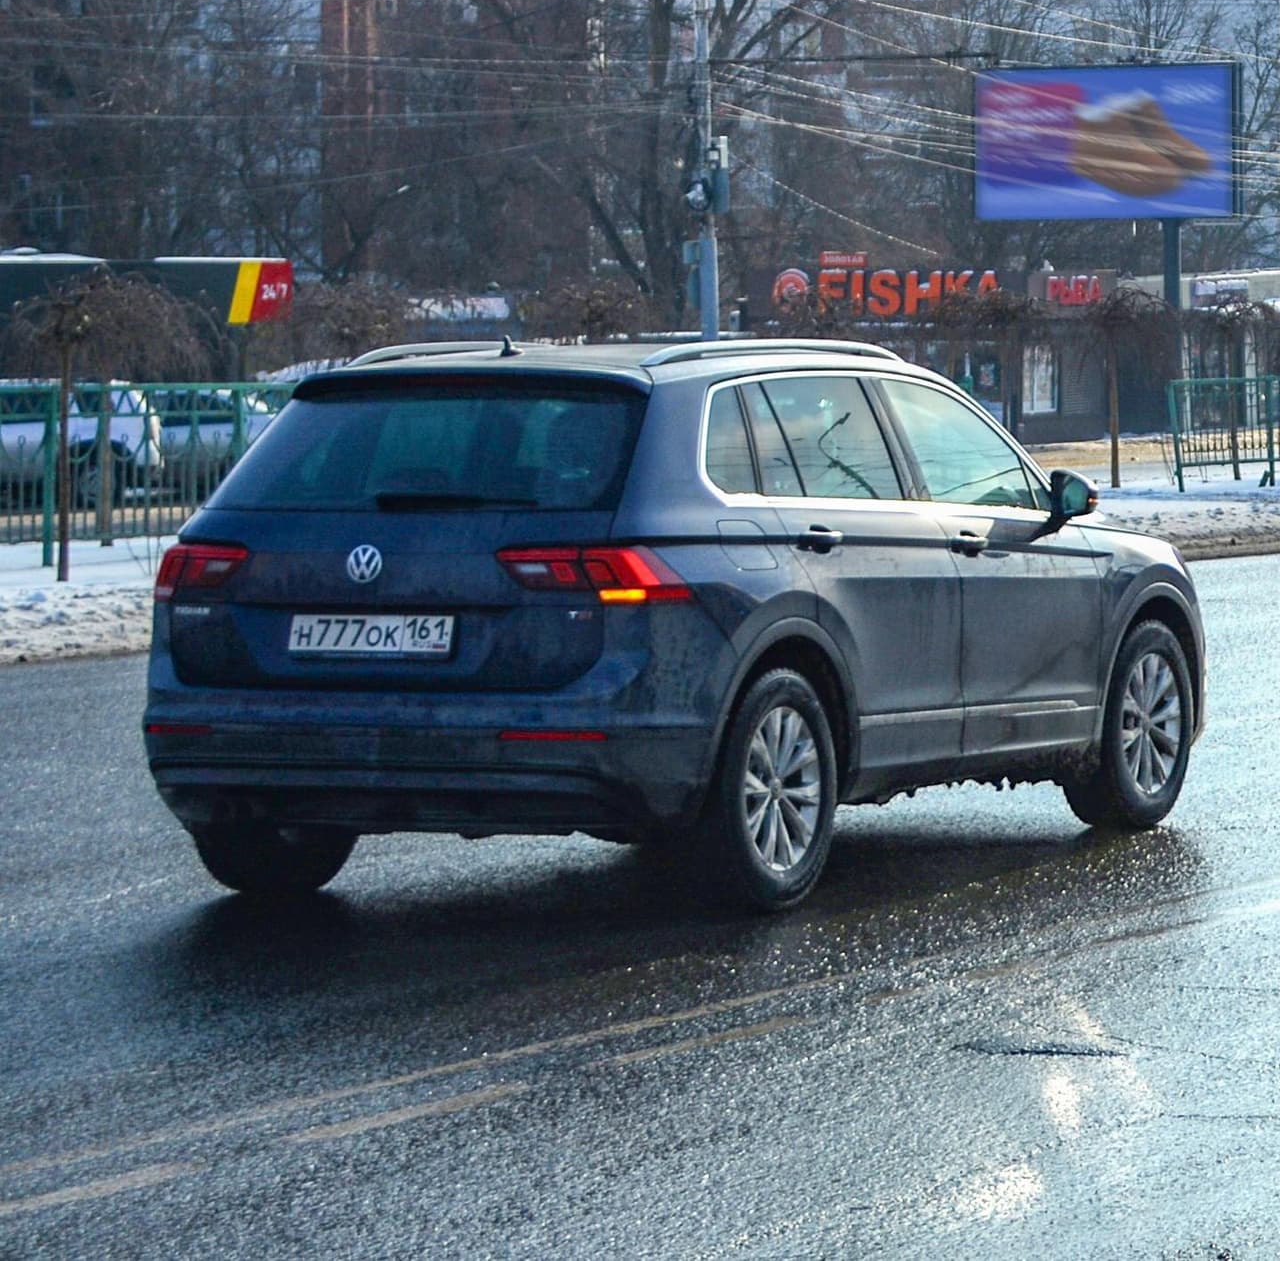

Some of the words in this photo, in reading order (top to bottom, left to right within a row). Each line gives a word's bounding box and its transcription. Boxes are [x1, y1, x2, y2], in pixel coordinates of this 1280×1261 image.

[262, 282, 288, 300] 24/7
[816, 269, 1001, 317] FISHKA
[1046, 275, 1103, 306] РЫБА
[296, 618, 400, 647] Н777ОК
[406, 618, 446, 640] 161
